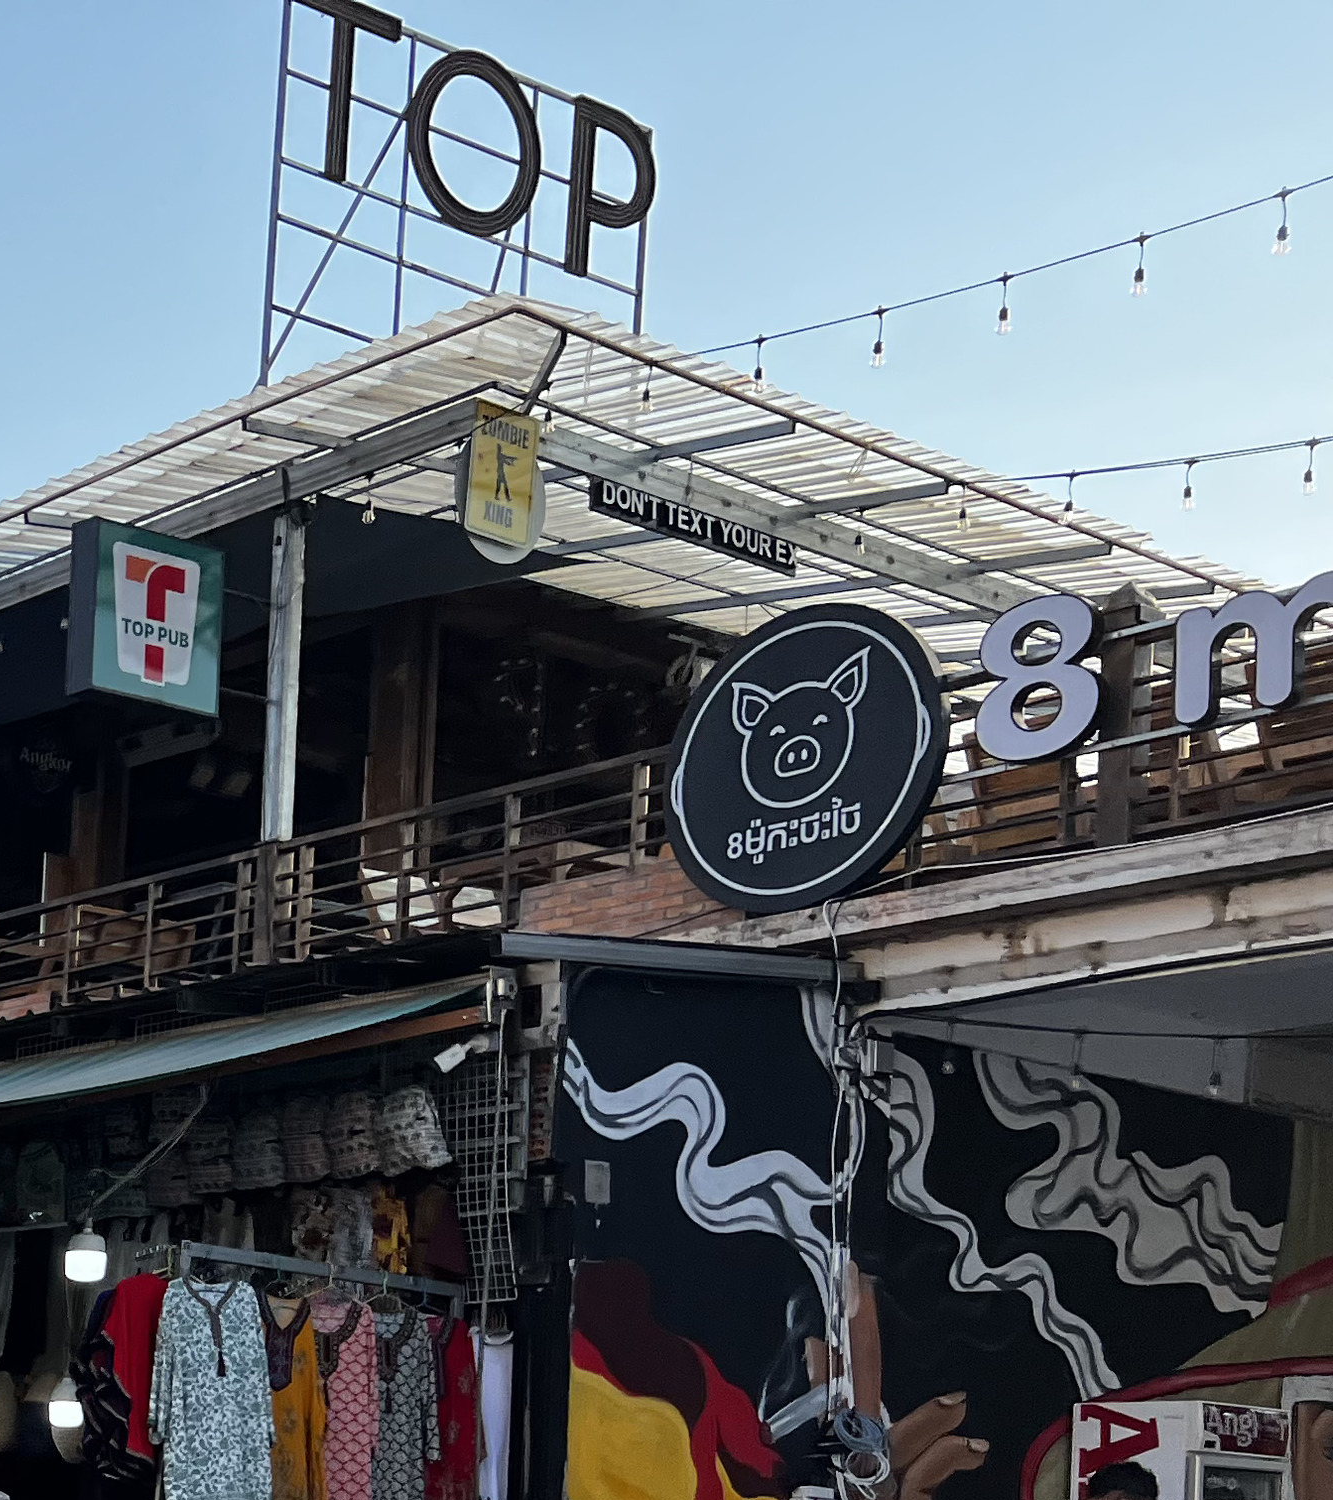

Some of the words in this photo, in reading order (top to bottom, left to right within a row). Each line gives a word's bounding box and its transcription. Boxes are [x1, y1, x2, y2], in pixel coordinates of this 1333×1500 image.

[290, 0, 656, 277] TOP
[481, 415, 530, 449] ZOMBIE
[483, 501, 514, 528] XING
[602, 479, 661, 520] DON'T
[665, 501, 716, 540] TEXT
[719, 518, 773, 559] YOUR
[121, 617, 155, 638] TOP
[158, 628, 189, 648] PUB
[975, 593, 1101, 762] 8
